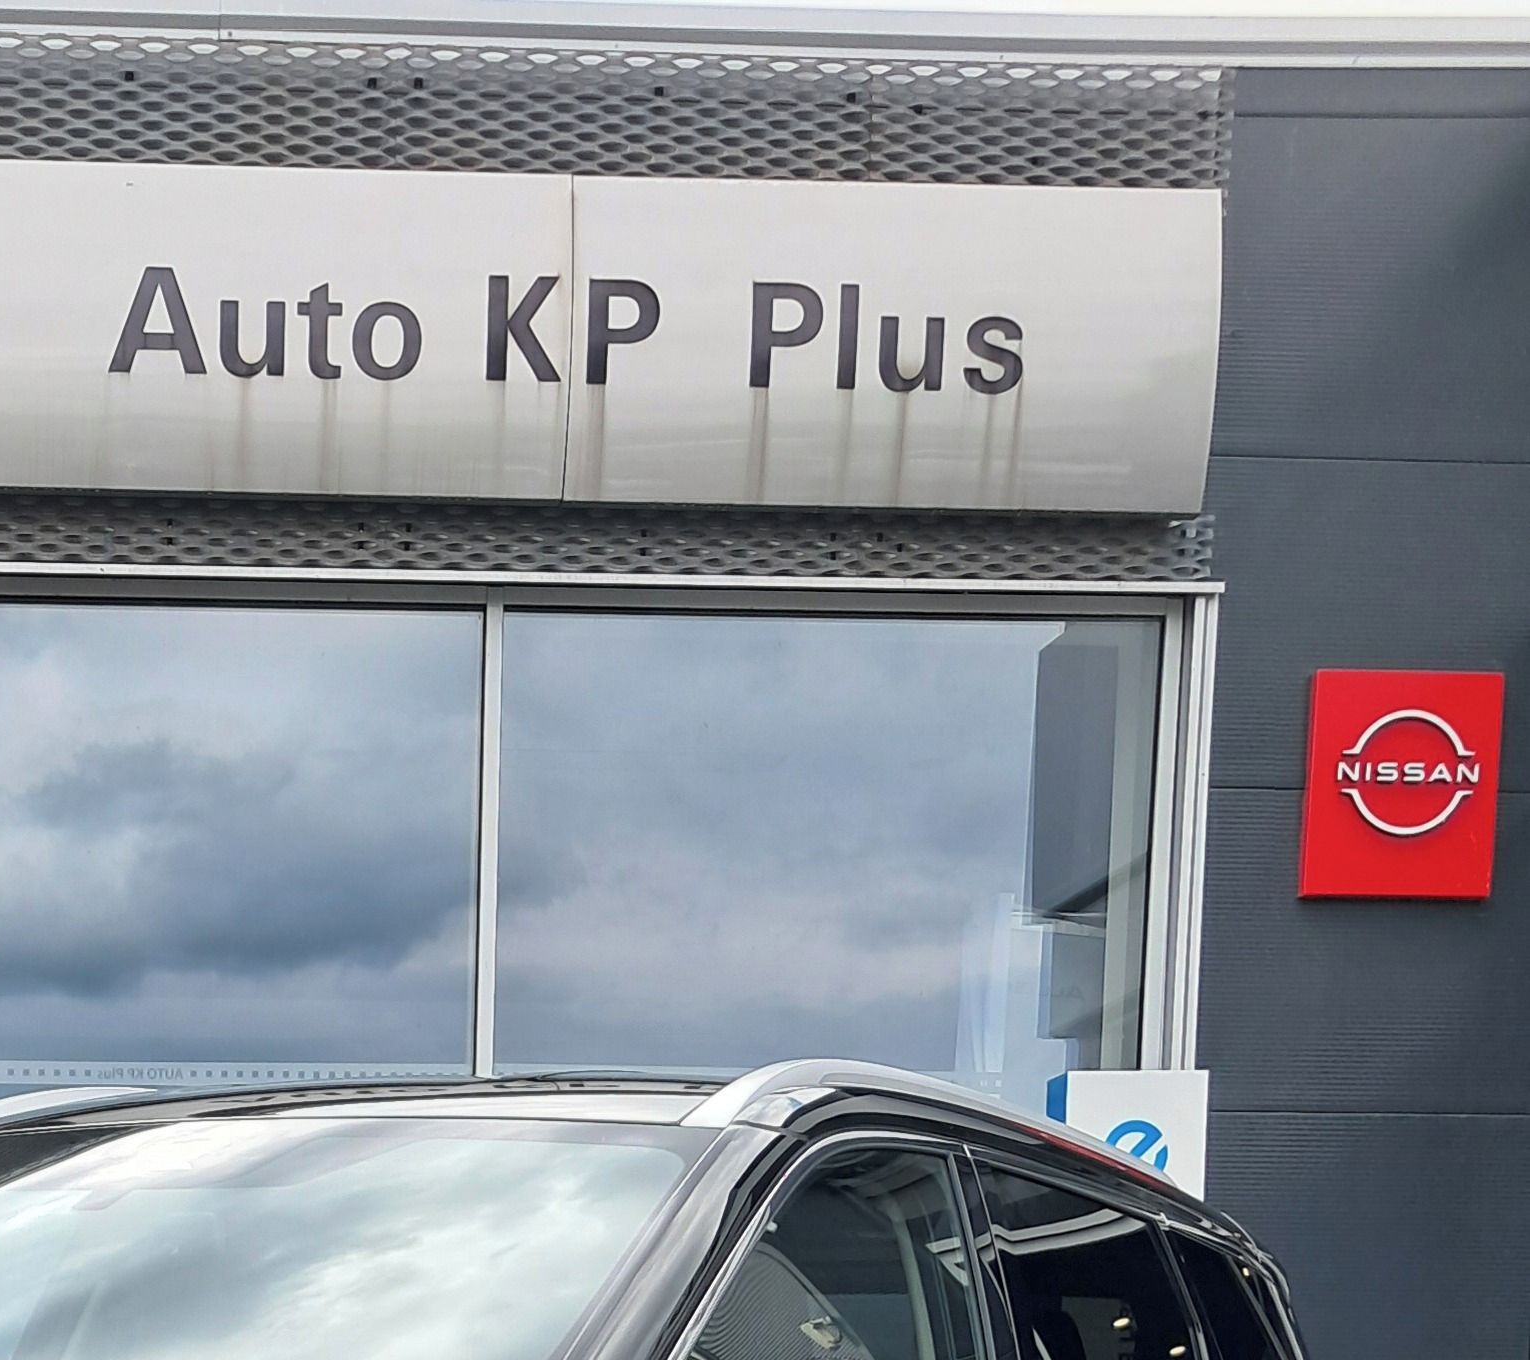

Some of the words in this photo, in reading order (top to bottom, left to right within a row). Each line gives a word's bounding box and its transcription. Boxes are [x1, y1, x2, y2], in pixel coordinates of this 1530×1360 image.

[107, 265, 423, 381] Auto
[484, 273, 661, 386] KP
[748, 280, 1025, 397] Plus
[1336, 761, 1481, 784] NISSAN
